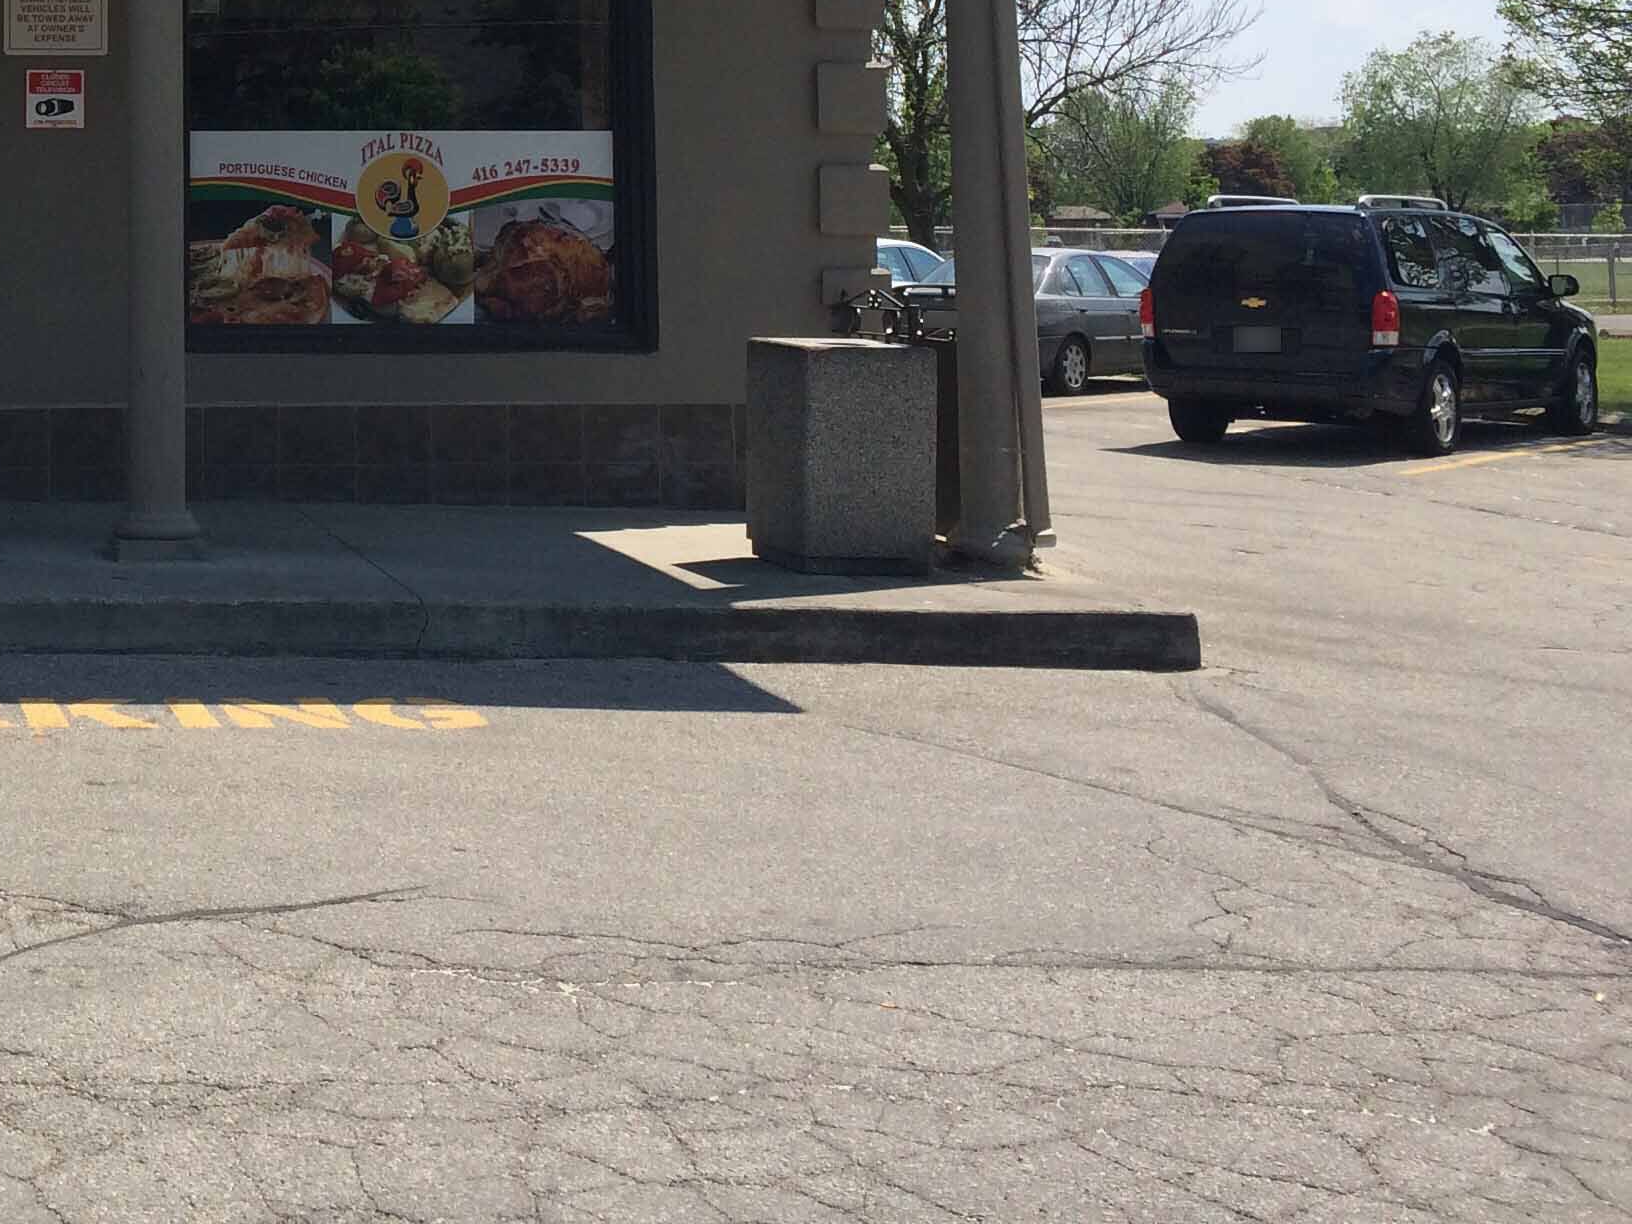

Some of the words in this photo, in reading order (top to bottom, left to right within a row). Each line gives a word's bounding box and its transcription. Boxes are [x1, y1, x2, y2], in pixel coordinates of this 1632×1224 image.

[21, 4, 66, 13] VEHICLES
[68, 4, 91, 13] WILL
[32, 14, 66, 23] TOWED
[67, 14, 94, 23] AWAY
[27, 24, 39, 33] AT
[34, 34, 77, 42] EXPENSE
[360, 133, 395, 167] ITAL
[399, 132, 444, 167] PIZZA
[471, 164, 499, 182] 416
[504, 158, 581, 176] 247-5339
[218, 162, 296, 178] PORTUGUESE
[298, 168, 348, 189] CHICKEN
